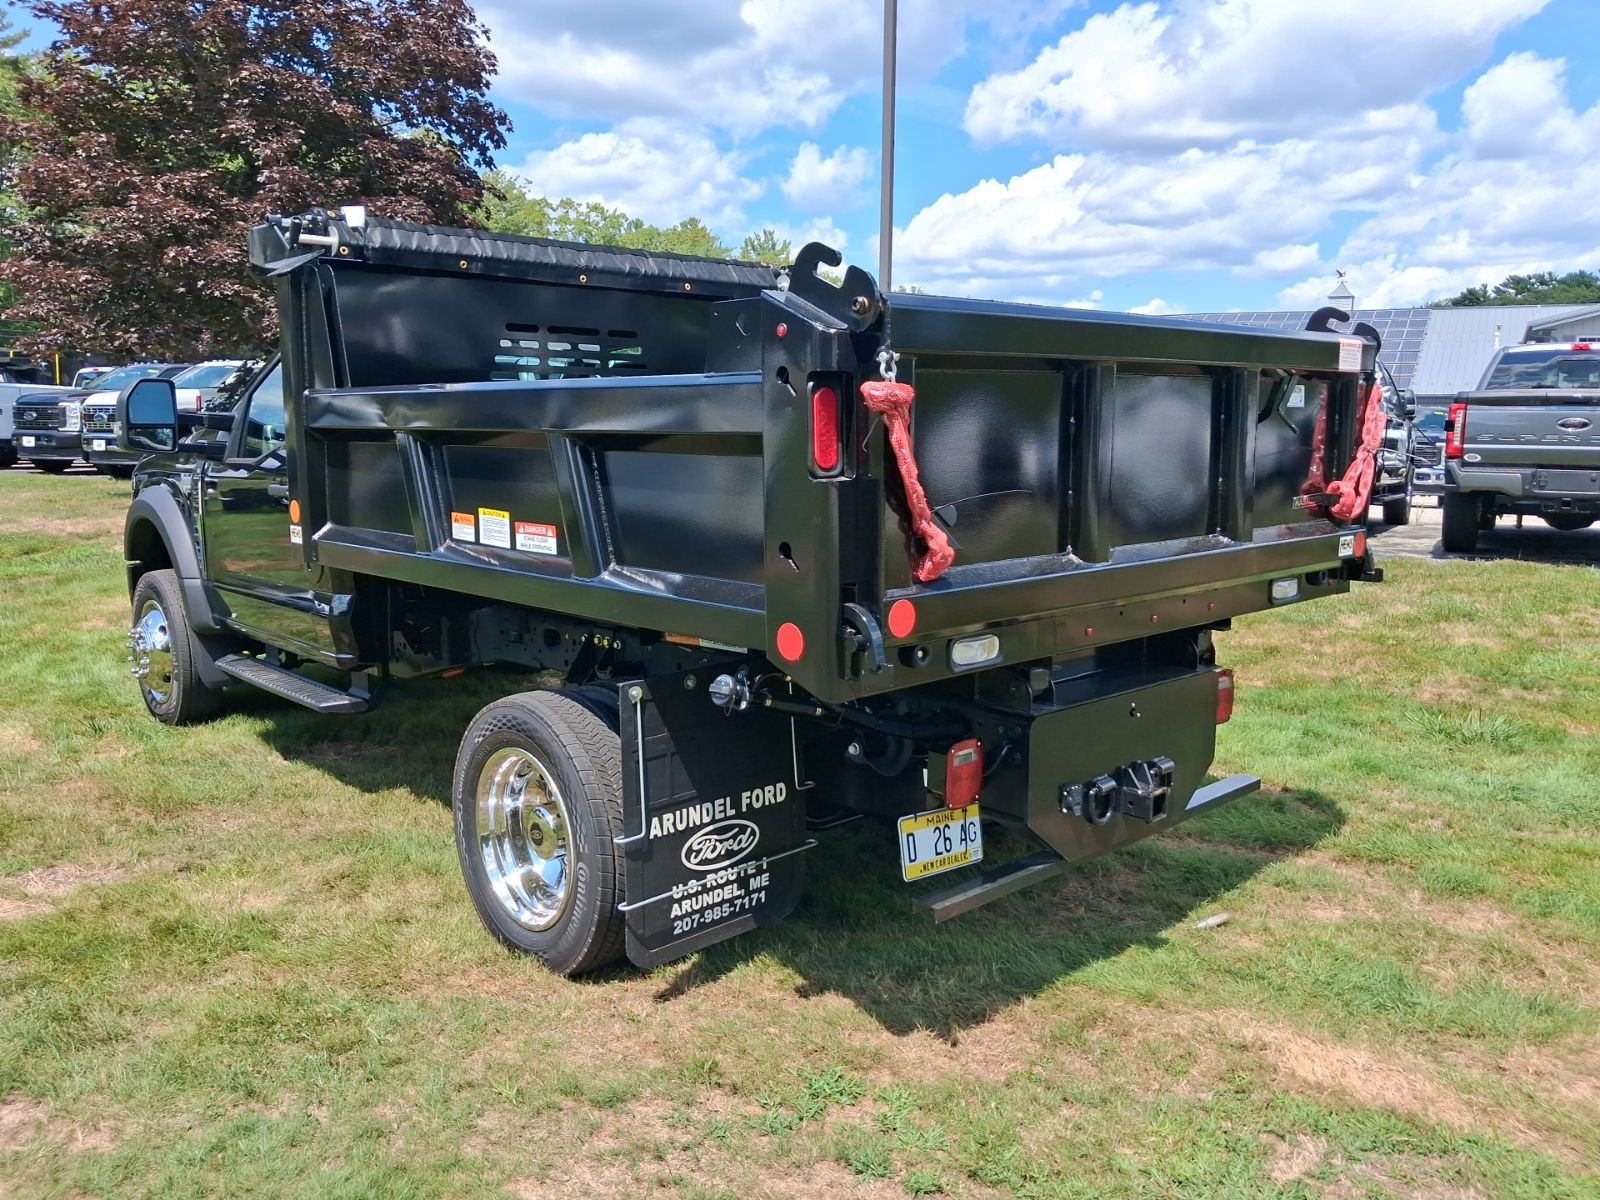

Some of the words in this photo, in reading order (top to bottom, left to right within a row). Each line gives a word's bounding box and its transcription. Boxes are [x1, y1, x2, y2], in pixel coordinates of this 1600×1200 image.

[524, 526, 546, 535] DANGER
[649, 796, 736, 839] ARUNDEL
[741, 782, 787, 813] FORD
[926, 811, 956, 826] MAINE
[688, 826, 755, 865] Ford
[906, 832, 917, 863] D
[933, 824, 952, 856] 26
[960, 821, 977, 846] AG
[672, 879, 702, 899] U.S.
[706, 860, 756, 888] ROUTE
[923, 860, 935, 872] NEW
[935, 855, 947, 869] CAR
[947, 852, 967, 867] DEALER
[670, 883, 745, 919] ARUNDEL,
[749, 872, 770, 891] ME
[673, 890, 766, 935] 207-985-7171
